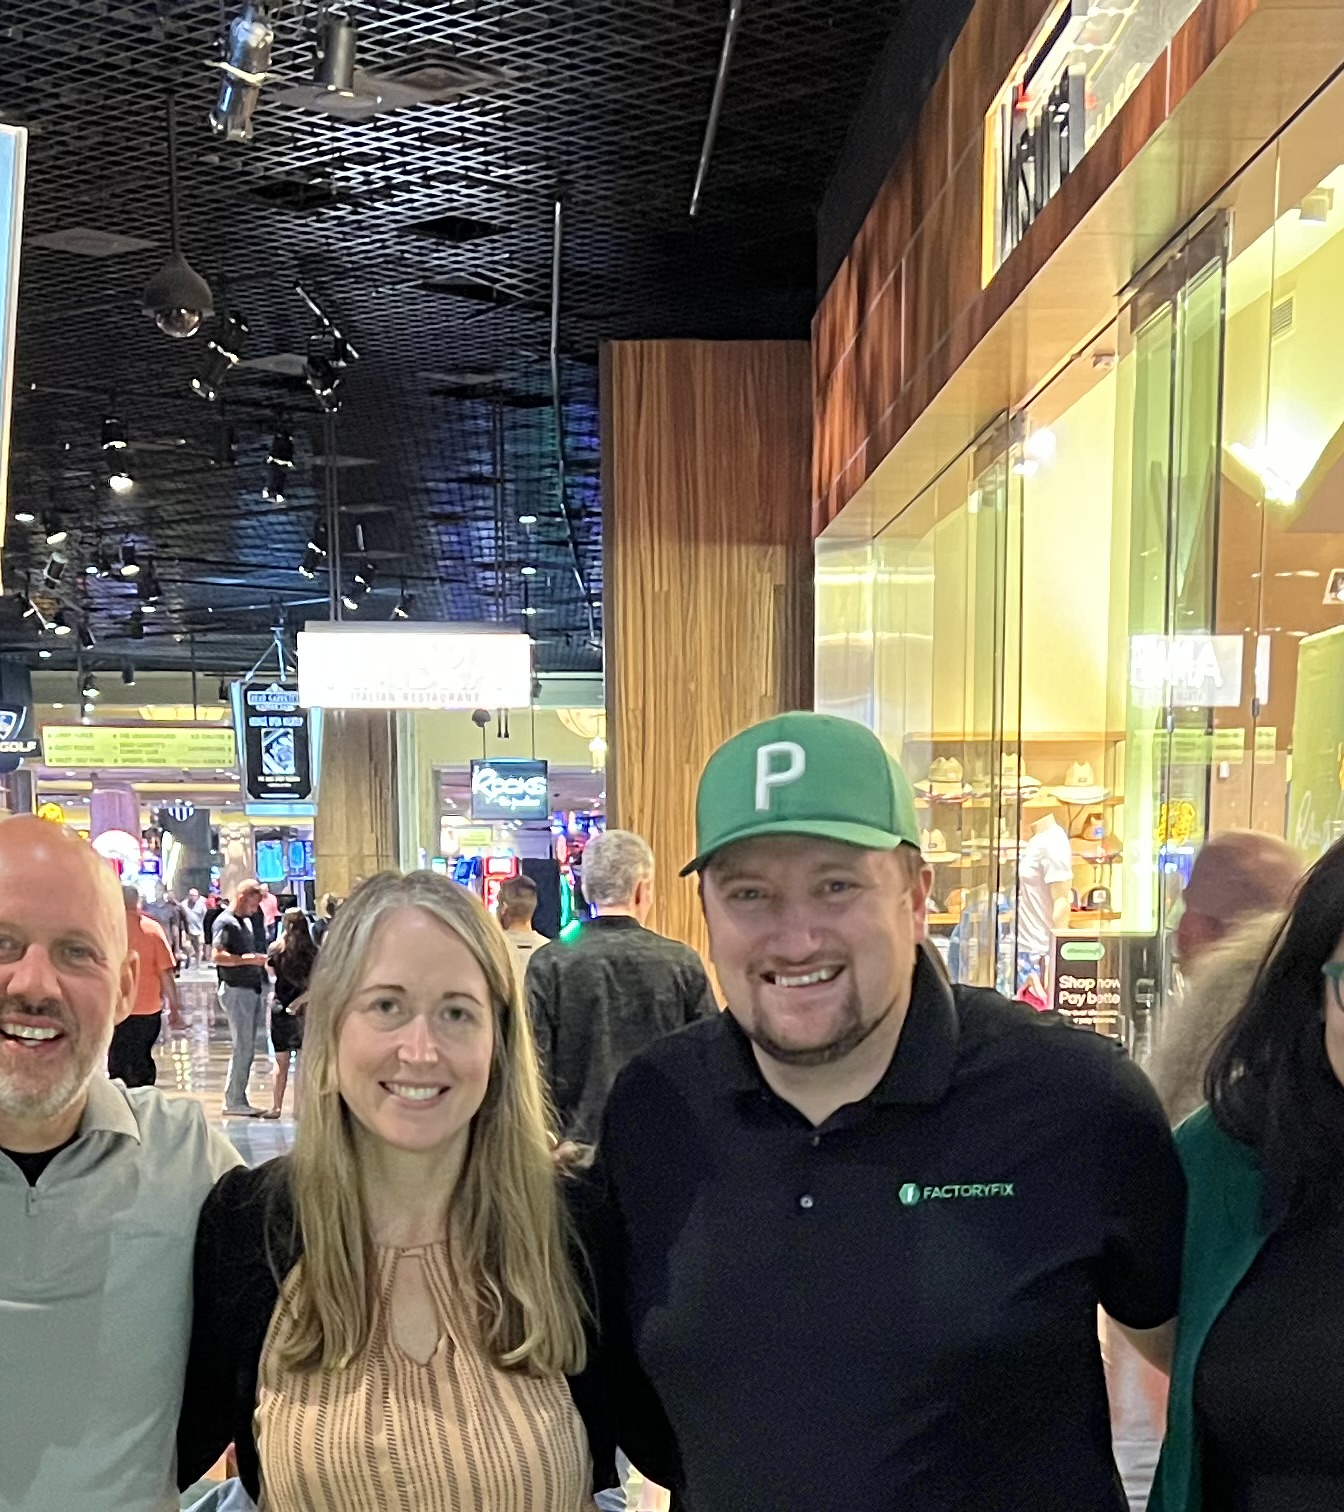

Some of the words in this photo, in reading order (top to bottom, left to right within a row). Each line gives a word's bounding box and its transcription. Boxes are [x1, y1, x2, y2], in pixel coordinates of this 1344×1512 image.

[403, 692, 480, 703] RESTAURANT
[755, 741, 806, 812] P
[1059, 975, 1096, 991] Shop
[1059, 991, 1086, 1007] Pay
[1087, 991, 1121, 1004] bette
[923, 1183, 1015, 1199] FACTORYFIX
